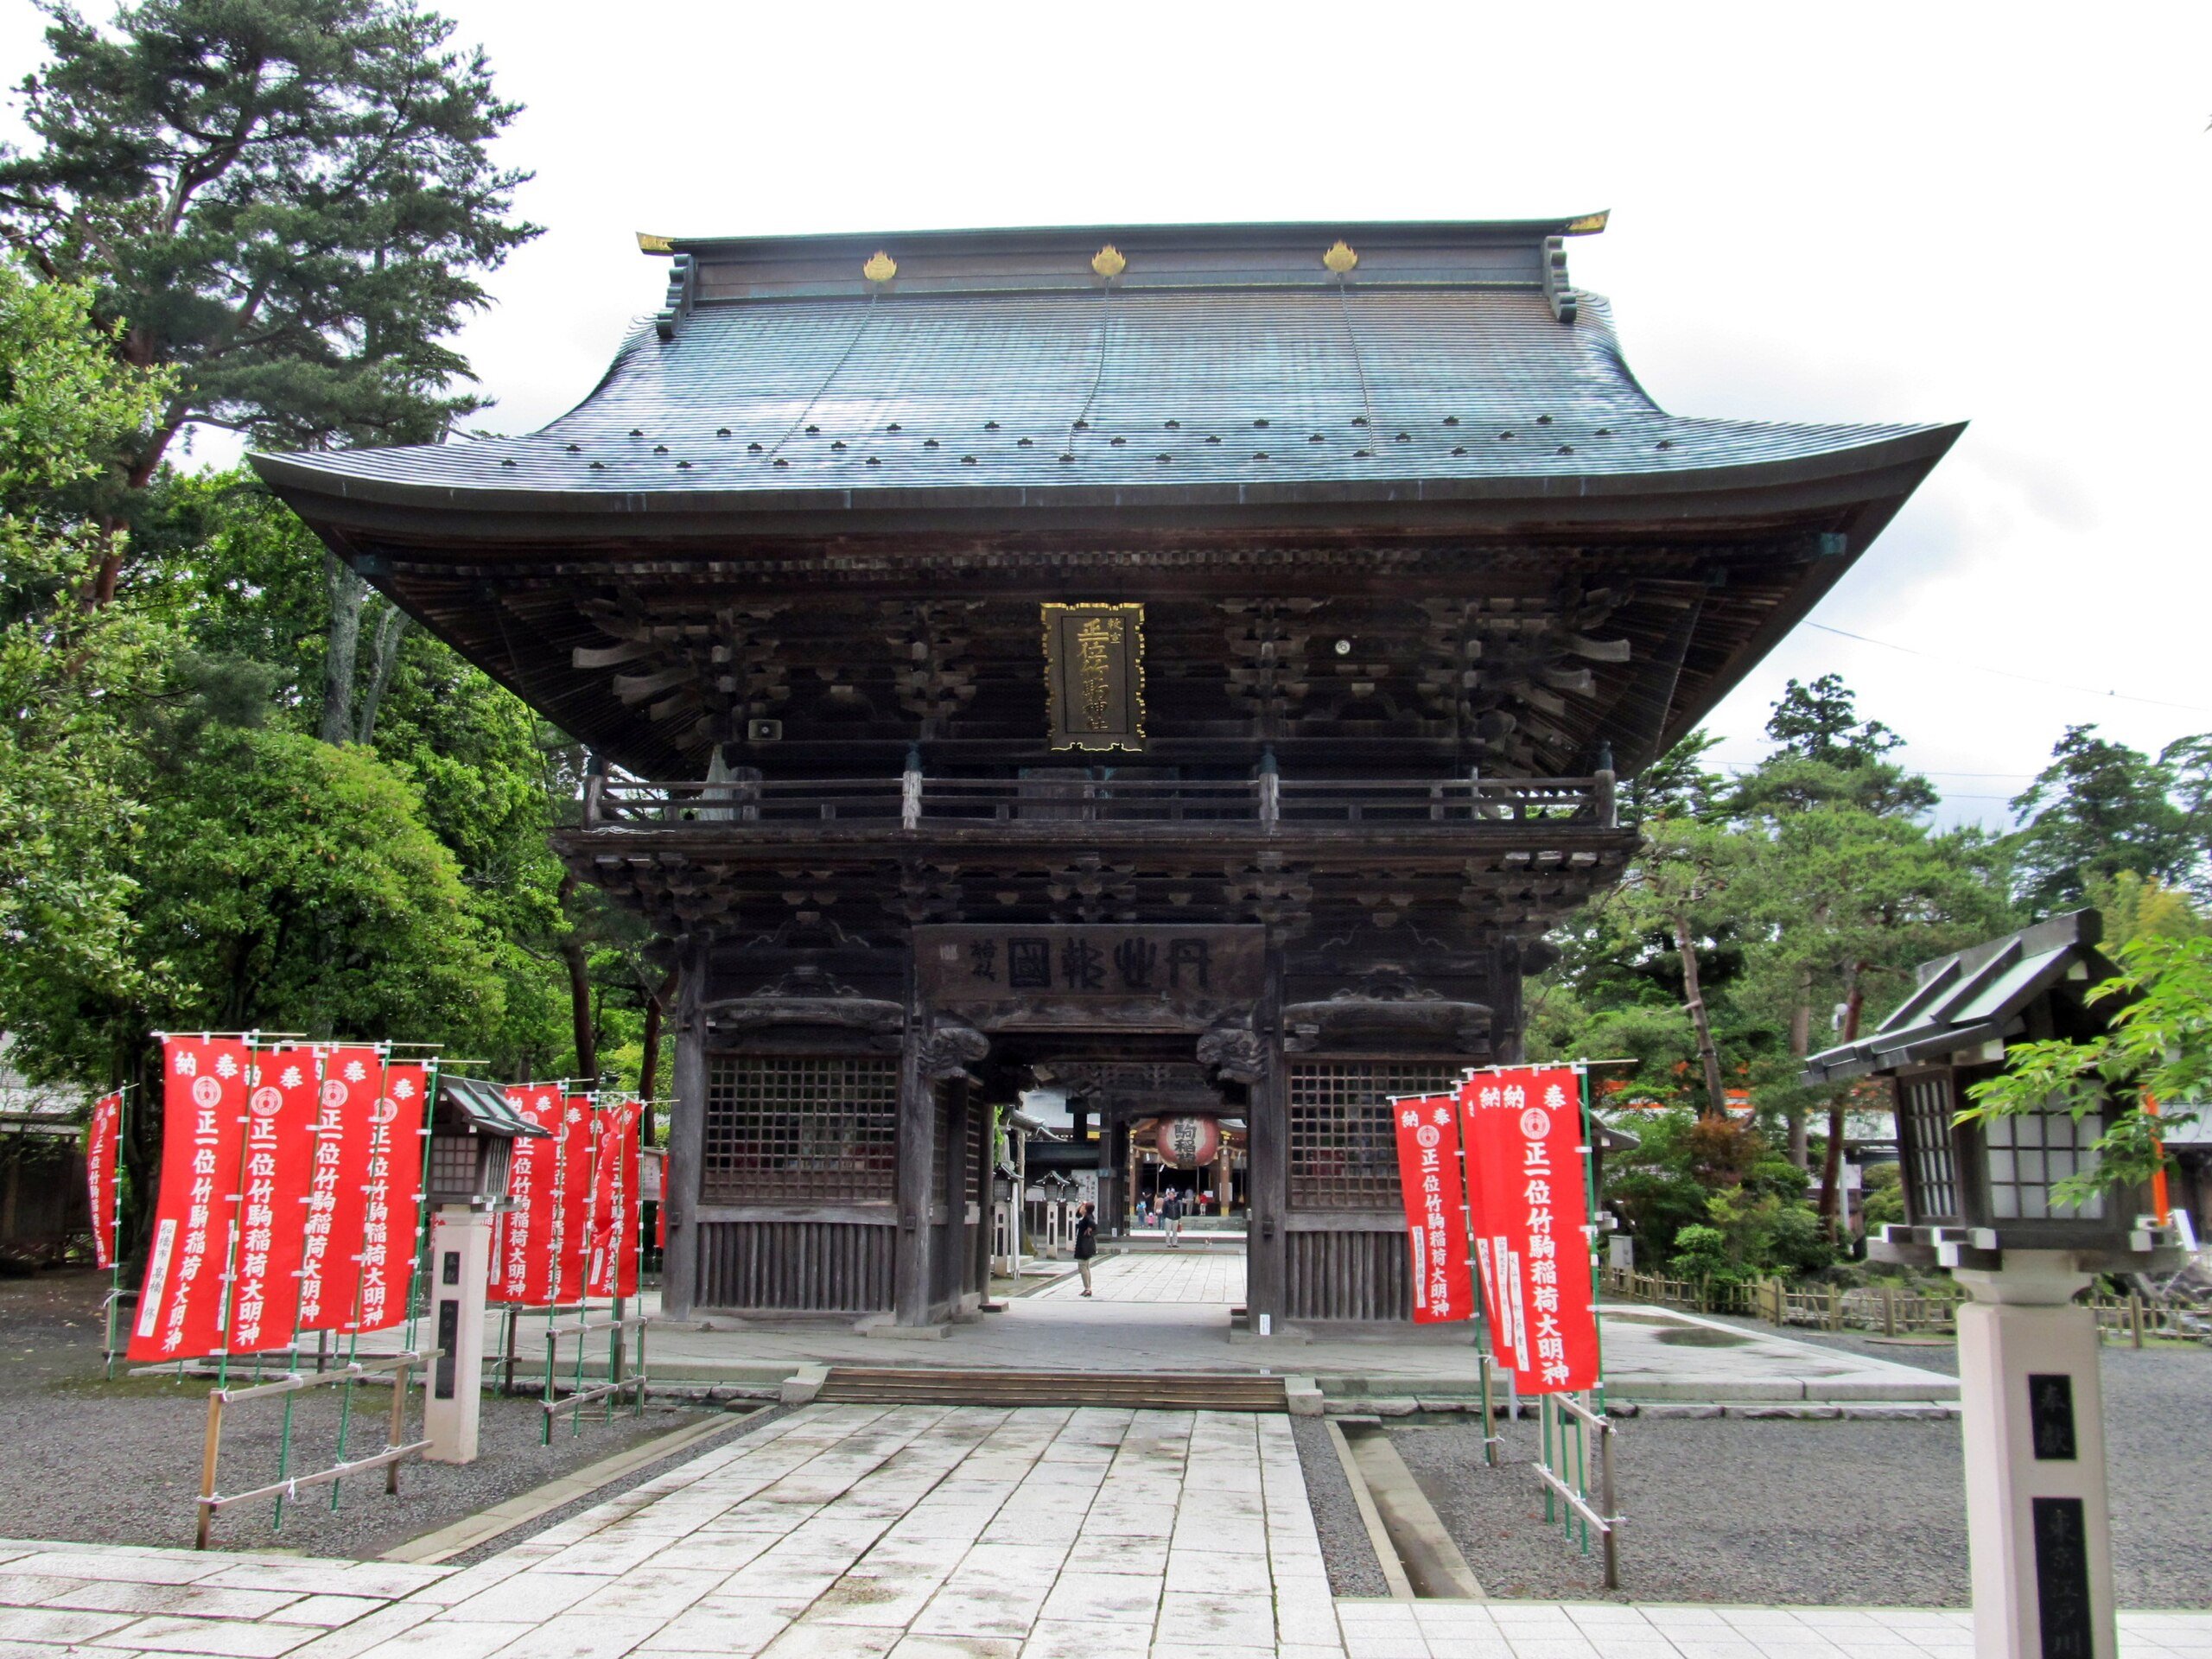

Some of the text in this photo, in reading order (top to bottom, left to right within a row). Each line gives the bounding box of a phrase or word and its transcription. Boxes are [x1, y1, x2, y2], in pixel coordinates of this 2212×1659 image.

[393, 1078, 415, 1100] 奉
[162, 1110, 219, 1352] 正一位竹駒稲荷大明神
[236, 1117, 277, 1346] 正一位竹駒稲荷大明神
[1421, 1148, 1451, 1318] 正一位竹駒稲荷大明神
[1523, 1142, 1570, 1386] 正一位竹駒稲荷大明神
